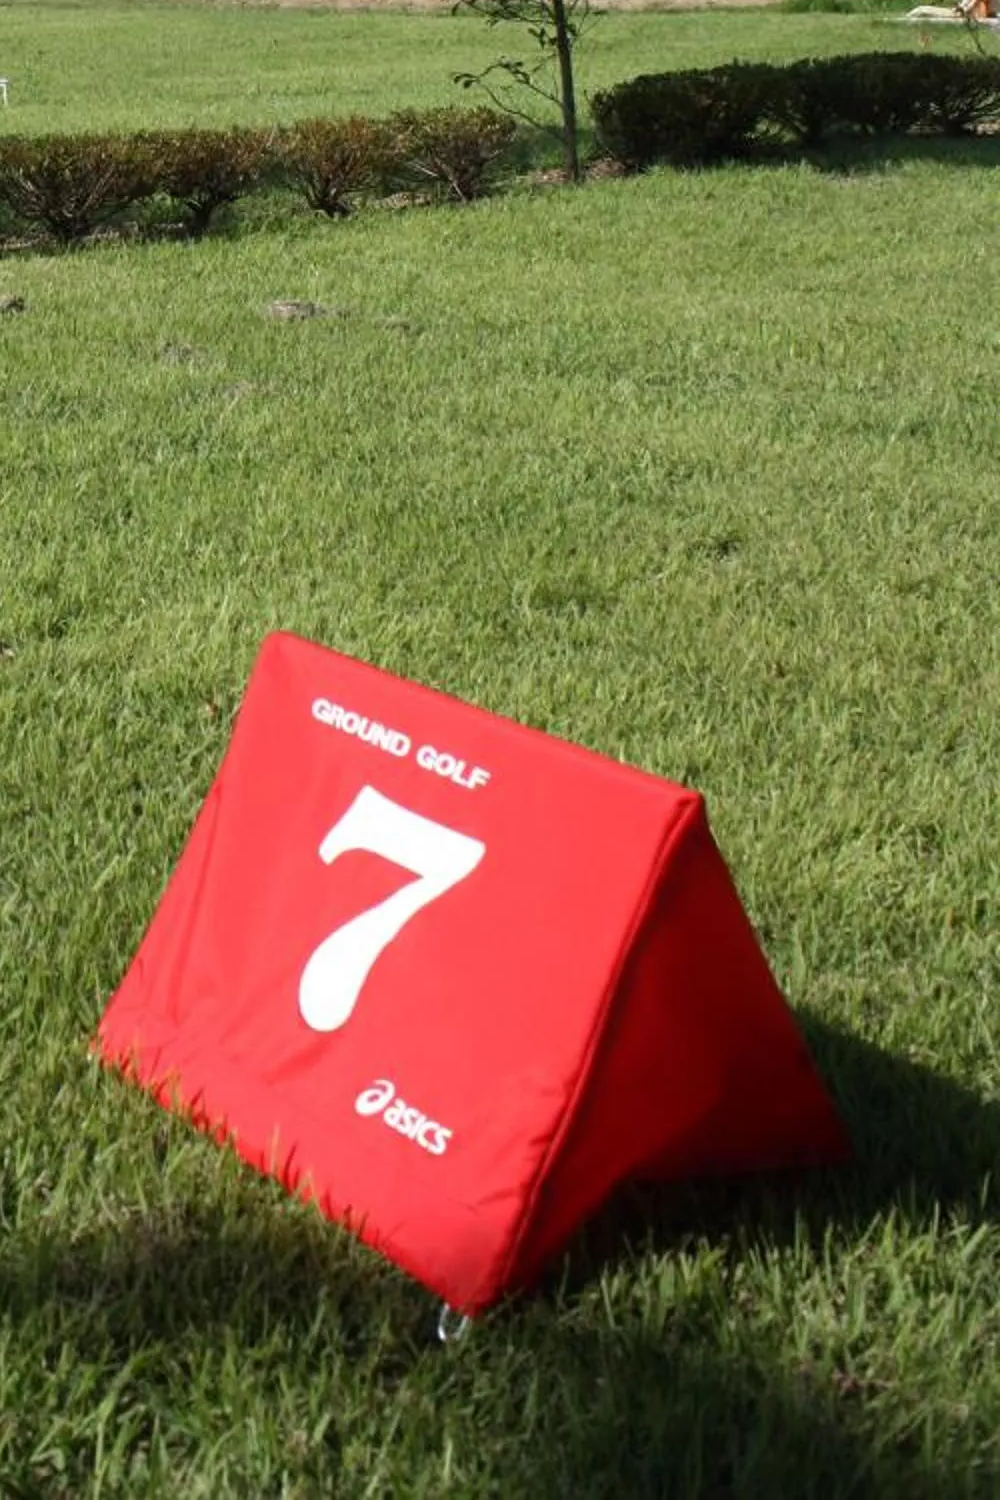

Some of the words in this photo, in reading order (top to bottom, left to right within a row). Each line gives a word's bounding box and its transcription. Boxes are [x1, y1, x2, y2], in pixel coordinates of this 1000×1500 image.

[311, 697, 412, 757] GROUND
[415, 744, 492, 790] GOLF
[298, 784, 486, 1032] 7
